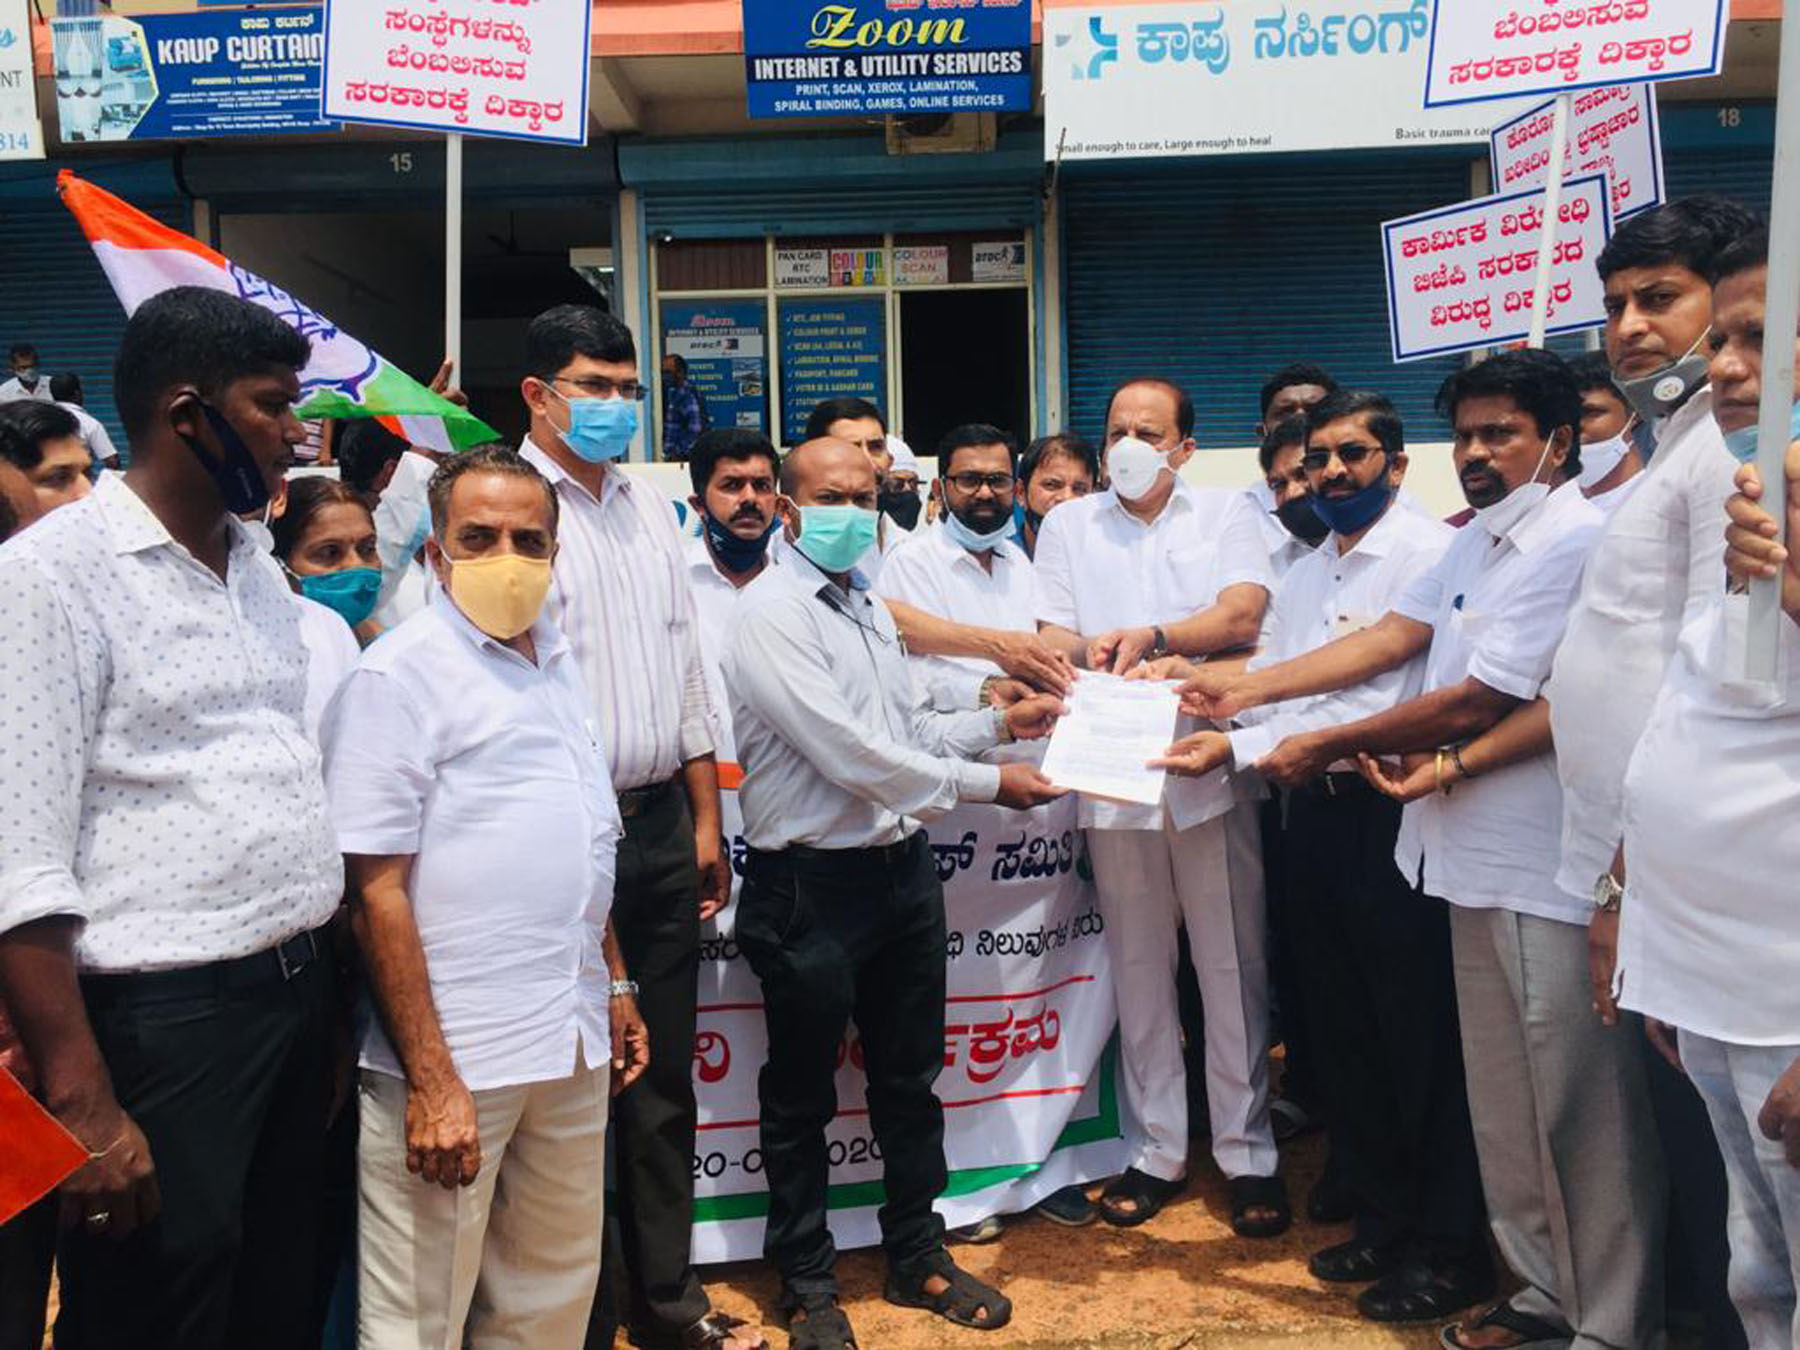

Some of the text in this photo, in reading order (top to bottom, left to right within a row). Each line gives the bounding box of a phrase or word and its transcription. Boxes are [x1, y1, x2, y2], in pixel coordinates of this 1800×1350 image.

[805, 4, 970, 49] Zoom
[157, 37, 219, 64] KAUP
[1137, 7, 1230, 75] ಕಾಪು
[754, 51, 1022, 80] INTERNET & UTILITY SERVICES
[796, 80, 979, 96] PRINT, SCAN, XEROX, LAMINATION,
[774, 94, 1005, 112] SPIRAL BINDING, GAMES, ONLINE SERVICES
[1717, 107, 1740, 127] 18
[1395, 128, 1425, 139] Basic
[1429, 127, 1470, 138] trauma
[1085, 141, 1124, 155] enough
[1126, 141, 1137, 151] to
[1165, 140, 1193, 152] Large
[1196, 137, 1234, 149] enough
[1237, 137, 1248, 146] to
[1250, 134, 1271, 146] heal
[390, 153, 412, 172] 15
[778, 252, 822, 261] PAN CARD
[833, 252, 883, 270] COLOUR
[991, 830, 1073, 880] ಸಮಿತಿ
